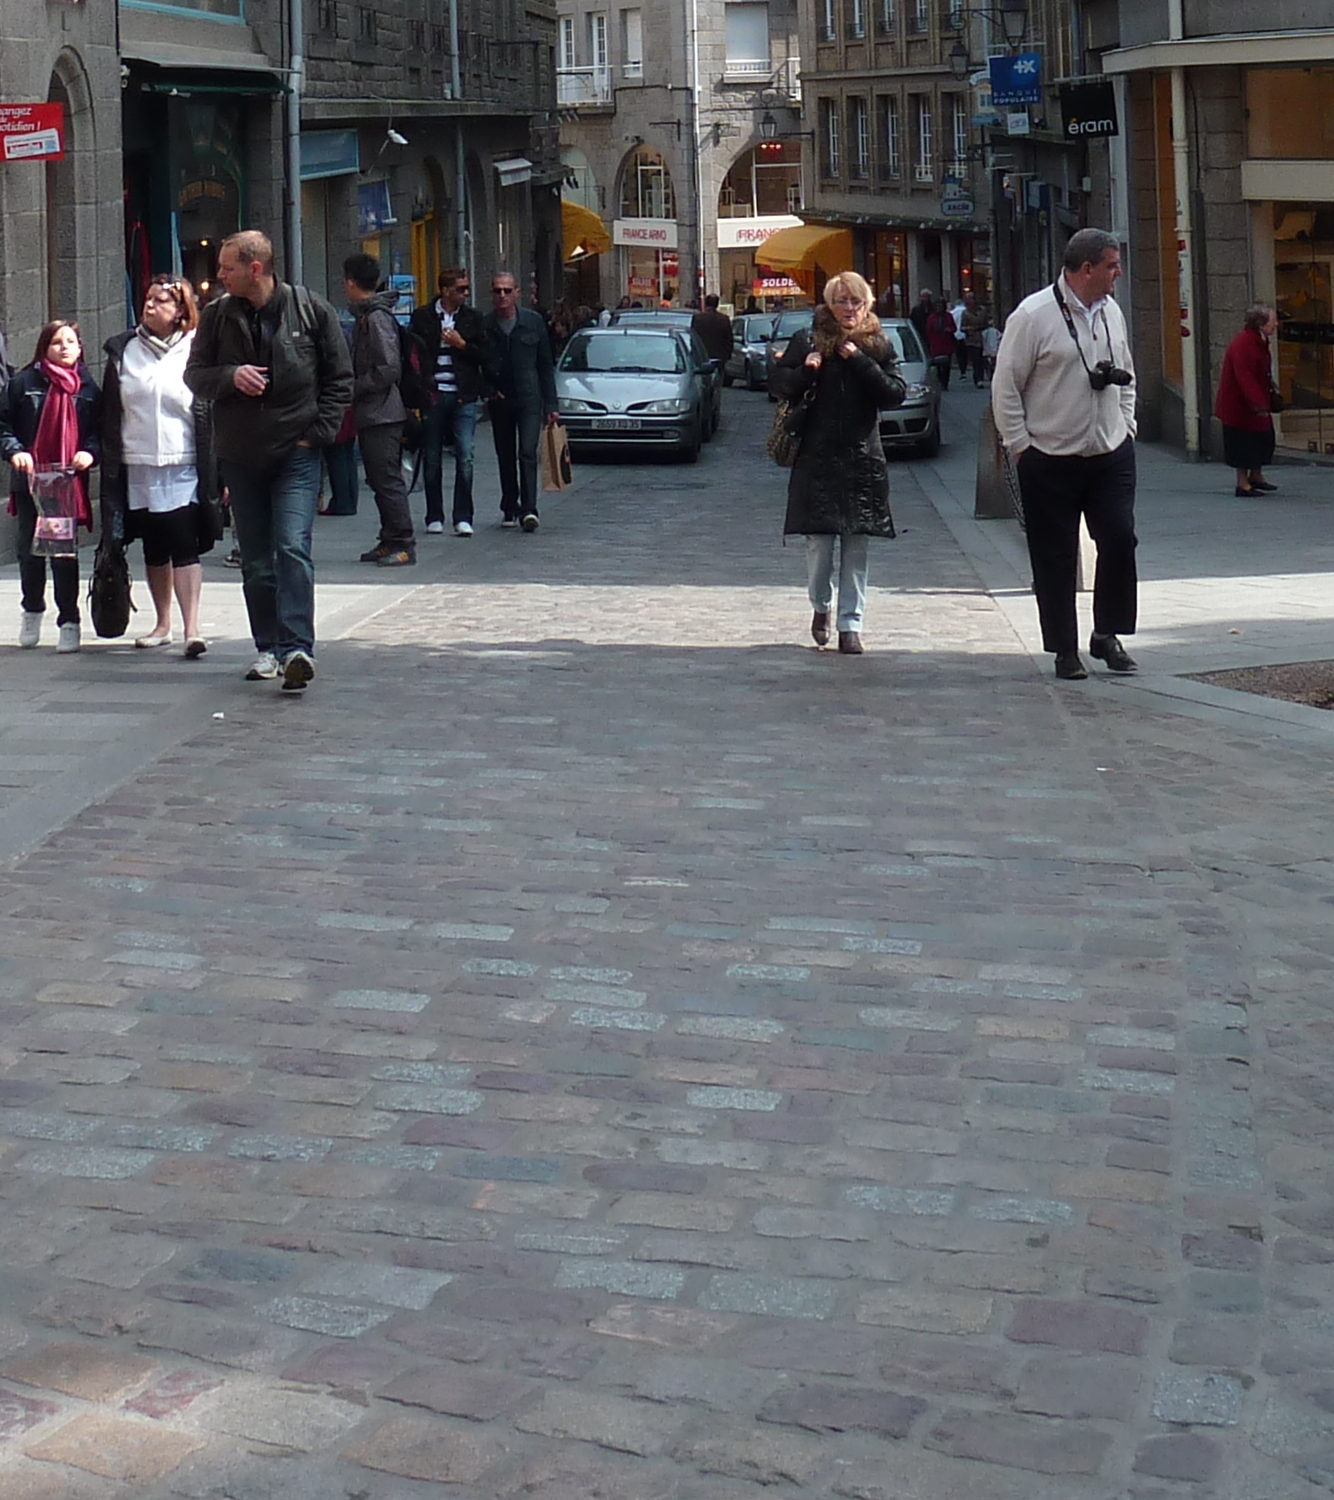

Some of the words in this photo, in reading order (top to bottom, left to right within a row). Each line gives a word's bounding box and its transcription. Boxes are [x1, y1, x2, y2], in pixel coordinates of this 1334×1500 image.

[1068, 118, 1114, 135] éram
[623, 227, 648, 239] FRANCE
[761, 278, 796, 288] SOLDE
